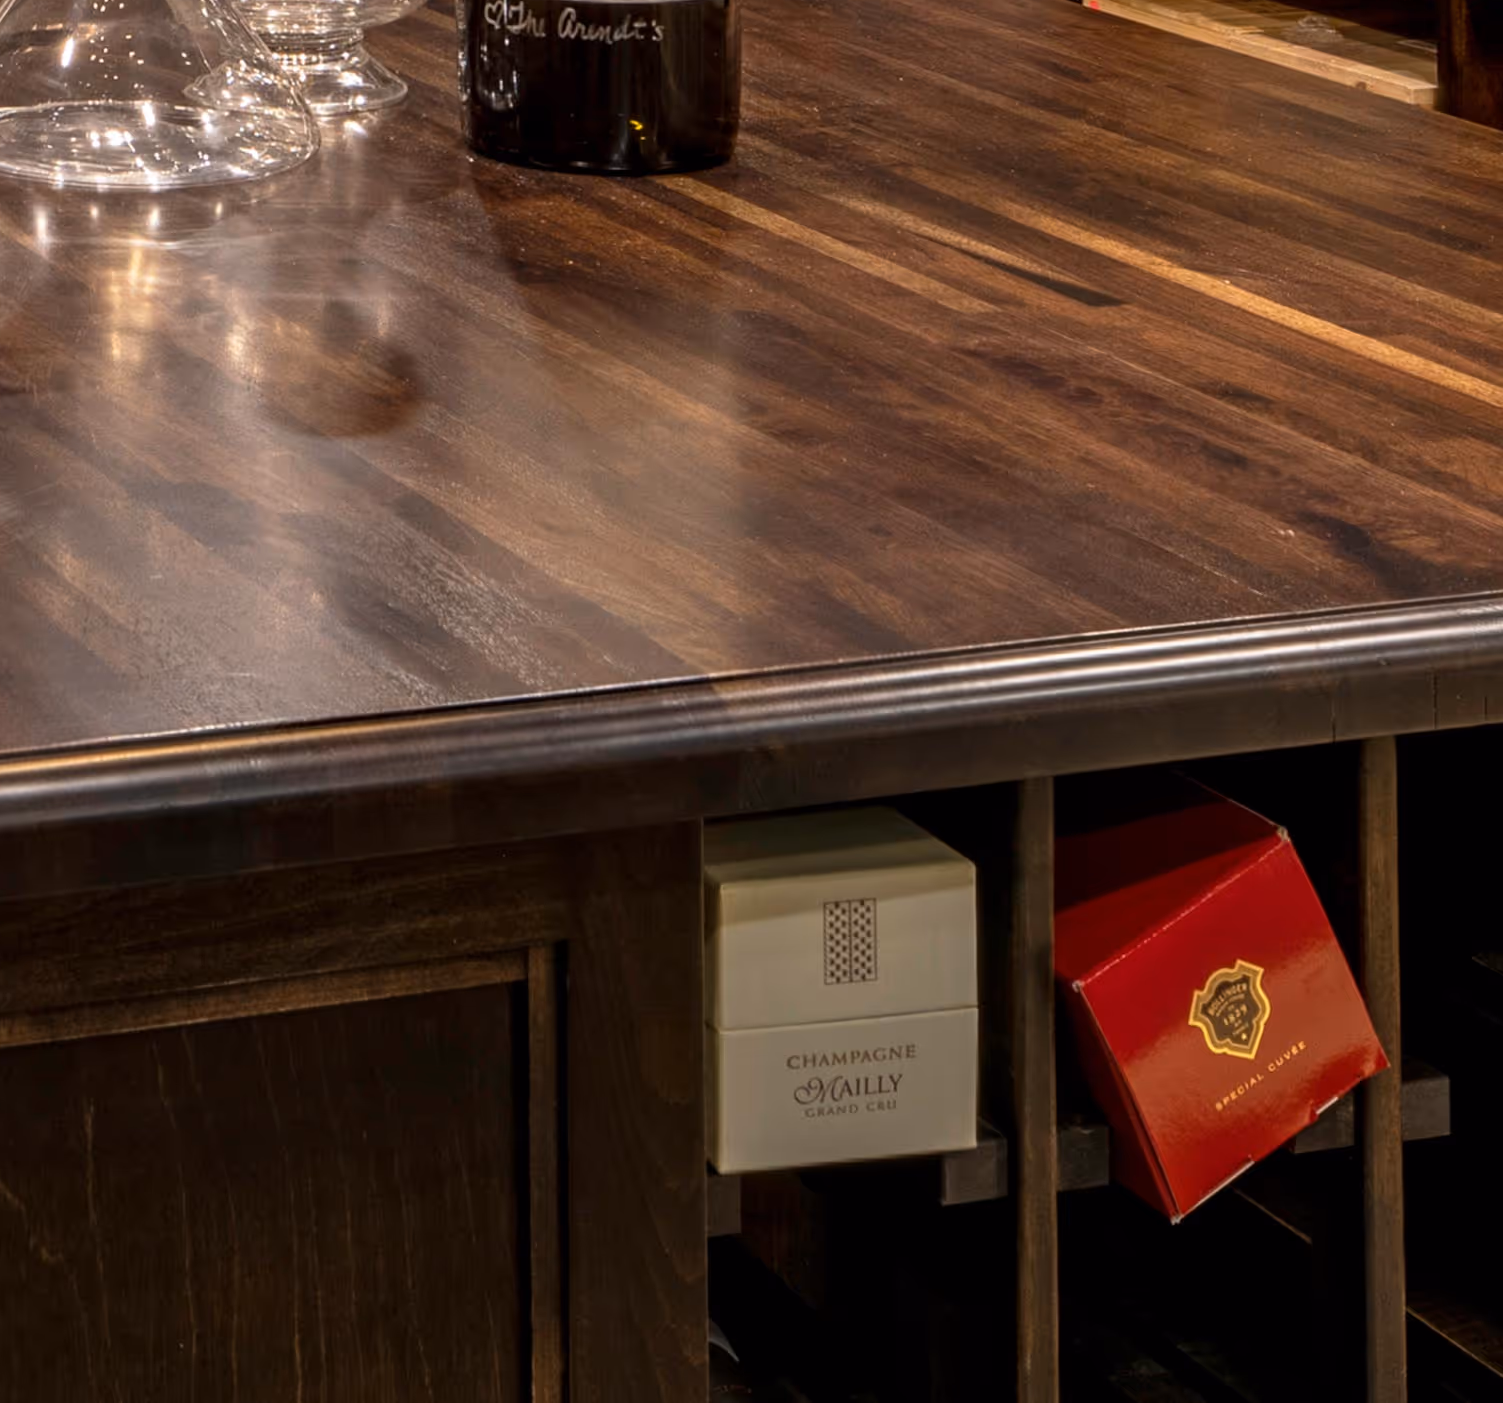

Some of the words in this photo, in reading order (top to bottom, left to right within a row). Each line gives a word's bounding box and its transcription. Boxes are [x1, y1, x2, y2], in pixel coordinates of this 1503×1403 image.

[785, 1044, 917, 1070] CHAMPAGNE
[1215, 1073, 1265, 1112] SPECIAL
[804, 1104, 859, 1118] GRAND
[866, 1100, 897, 1112] CRU
